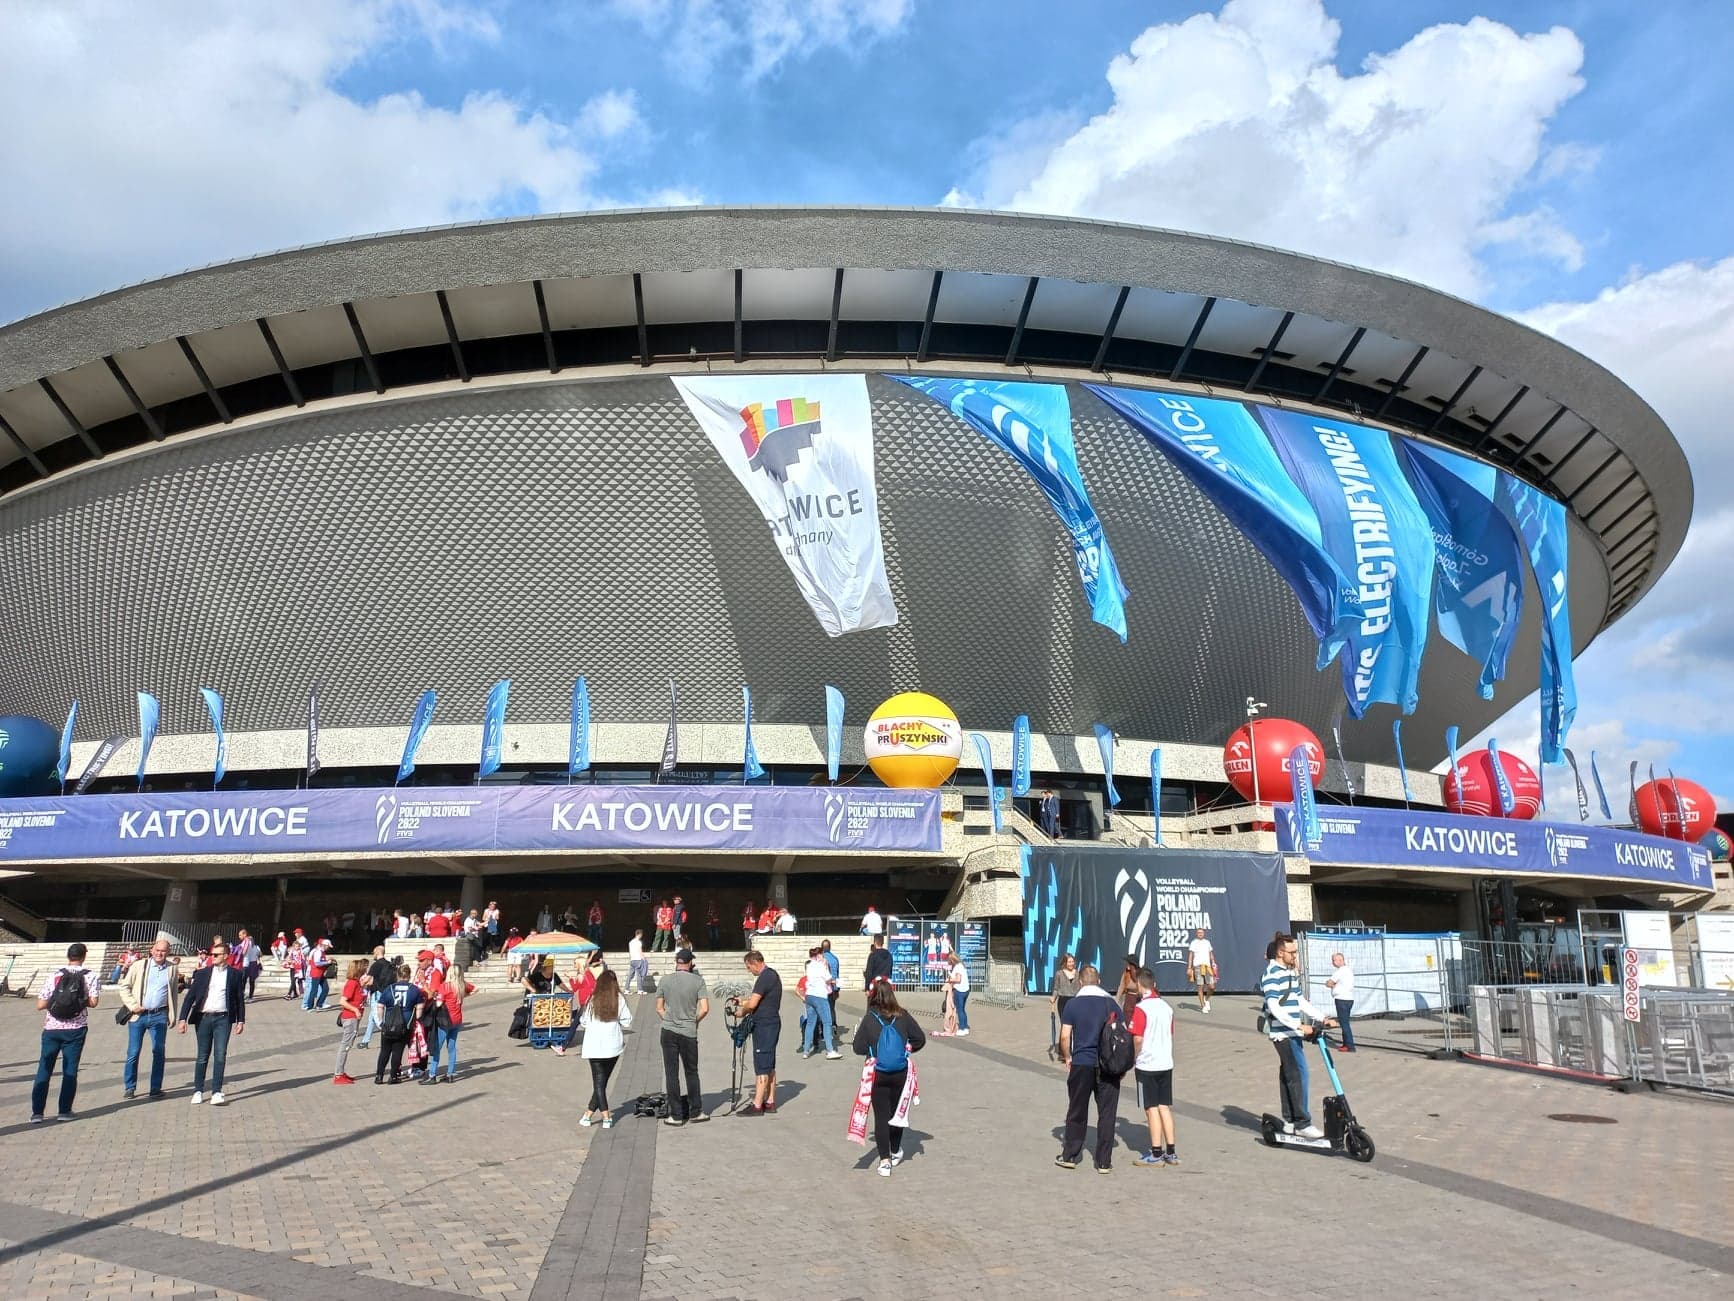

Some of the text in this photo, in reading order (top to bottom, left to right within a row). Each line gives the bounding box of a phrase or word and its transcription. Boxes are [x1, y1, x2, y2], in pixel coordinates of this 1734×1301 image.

[1312, 425, 1397, 636] ELECTRIFYING!
[878, 722, 923, 732] BLACHY
[877, 732, 947, 745] PRUSZYŃSKI
[1016, 727, 1025, 780] KATOWICE
[1296, 760, 1310, 821] KATOWICE
[399, 805, 471, 817] POLAND SLOVENIA
[551, 803, 753, 831] KATOWICE
[848, 807, 915, 819] POLAND SLOVENIA
[119, 807, 309, 839] KATOWICE
[848, 818, 868, 828] 2022
[1405, 826, 1518, 857] KATOWICE
[1615, 842, 1675, 871] KATOWICE
[1156, 894, 1201, 911] POLAND
[1158, 912, 1212, 930] SLOVENIA
[1159, 930, 1189, 947] 2022
